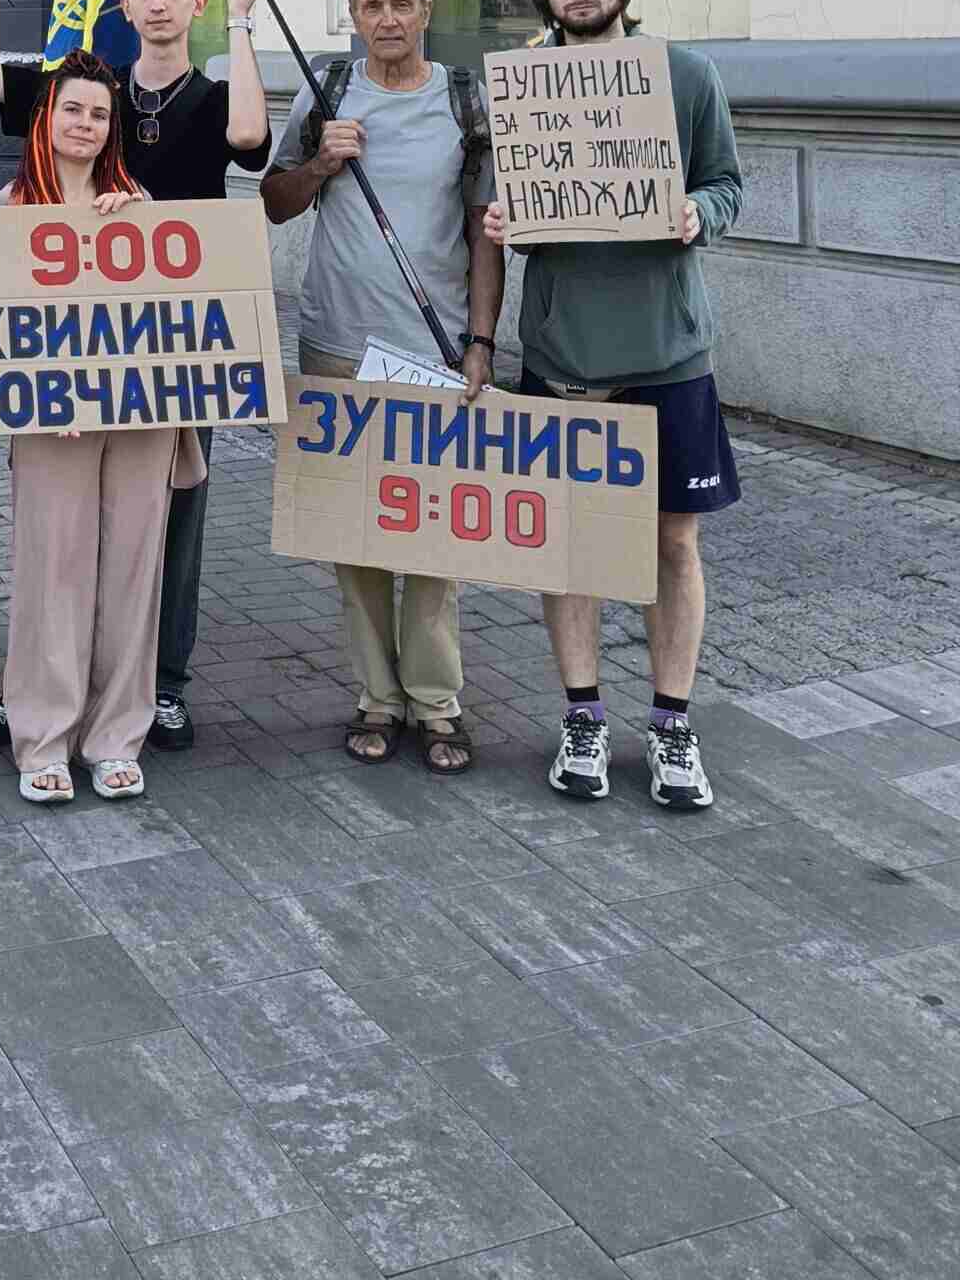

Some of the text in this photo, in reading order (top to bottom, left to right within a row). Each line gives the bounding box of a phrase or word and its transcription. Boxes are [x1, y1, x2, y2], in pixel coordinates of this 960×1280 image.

[492, 58, 651, 102] ЗУПИНИСЬ
[494, 105, 623, 135] ЗА ТИХ ЧИЇ
[496, 141, 574, 172] СЕРЦЯ
[30, 220, 201, 286] 9:00
[297, 389, 645, 487] ЗУПИНИСЬ
[377, 474, 546, 548] 9:00
